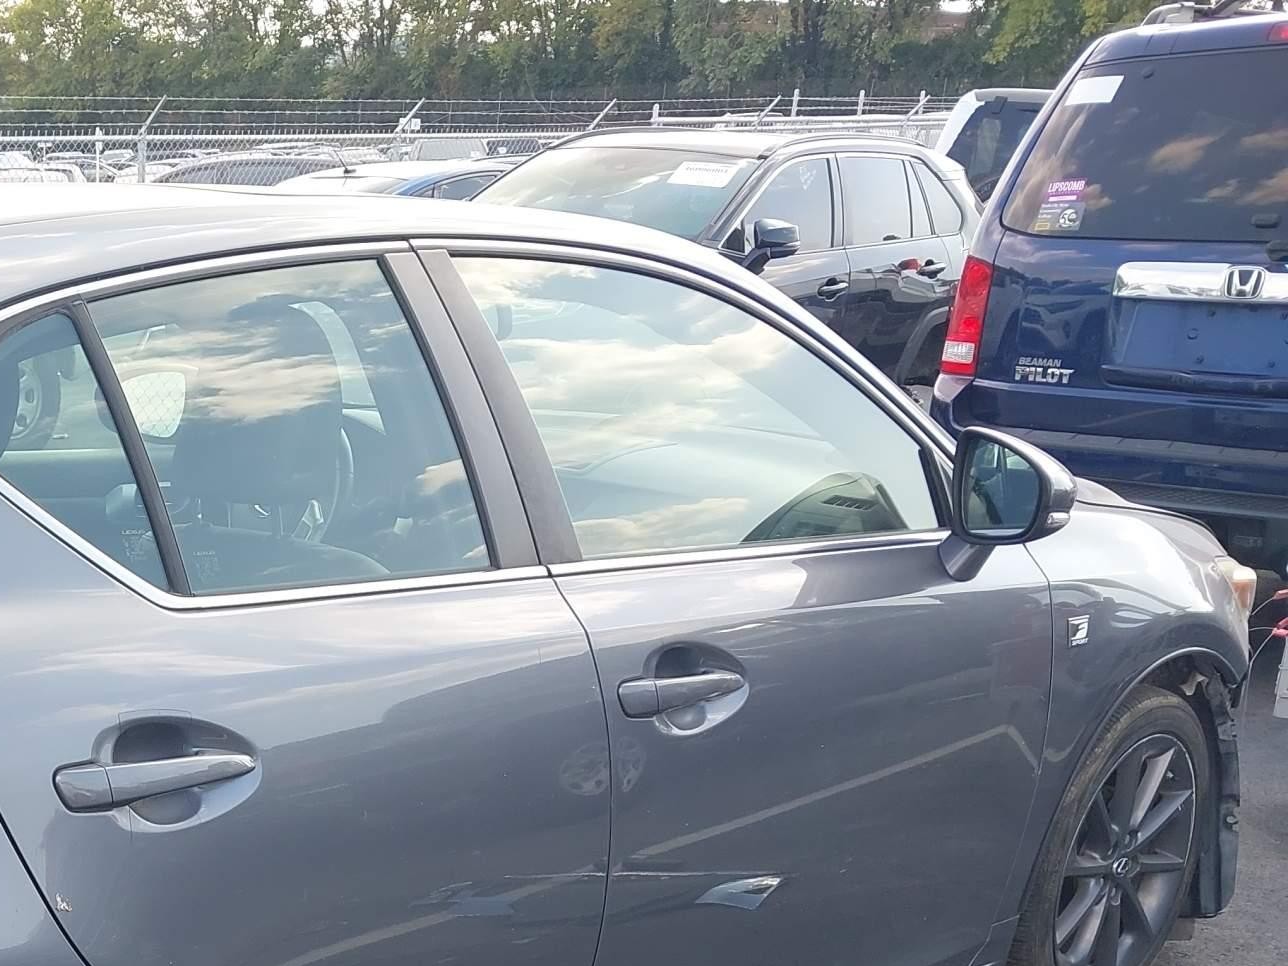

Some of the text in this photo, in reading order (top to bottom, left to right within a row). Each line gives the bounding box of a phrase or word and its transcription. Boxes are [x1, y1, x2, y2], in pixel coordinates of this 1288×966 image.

[1047, 180, 1086, 193] LIPSCOMB
[1018, 356, 1062, 367] BEAMAN
[1014, 365, 1076, 384] PILOT
